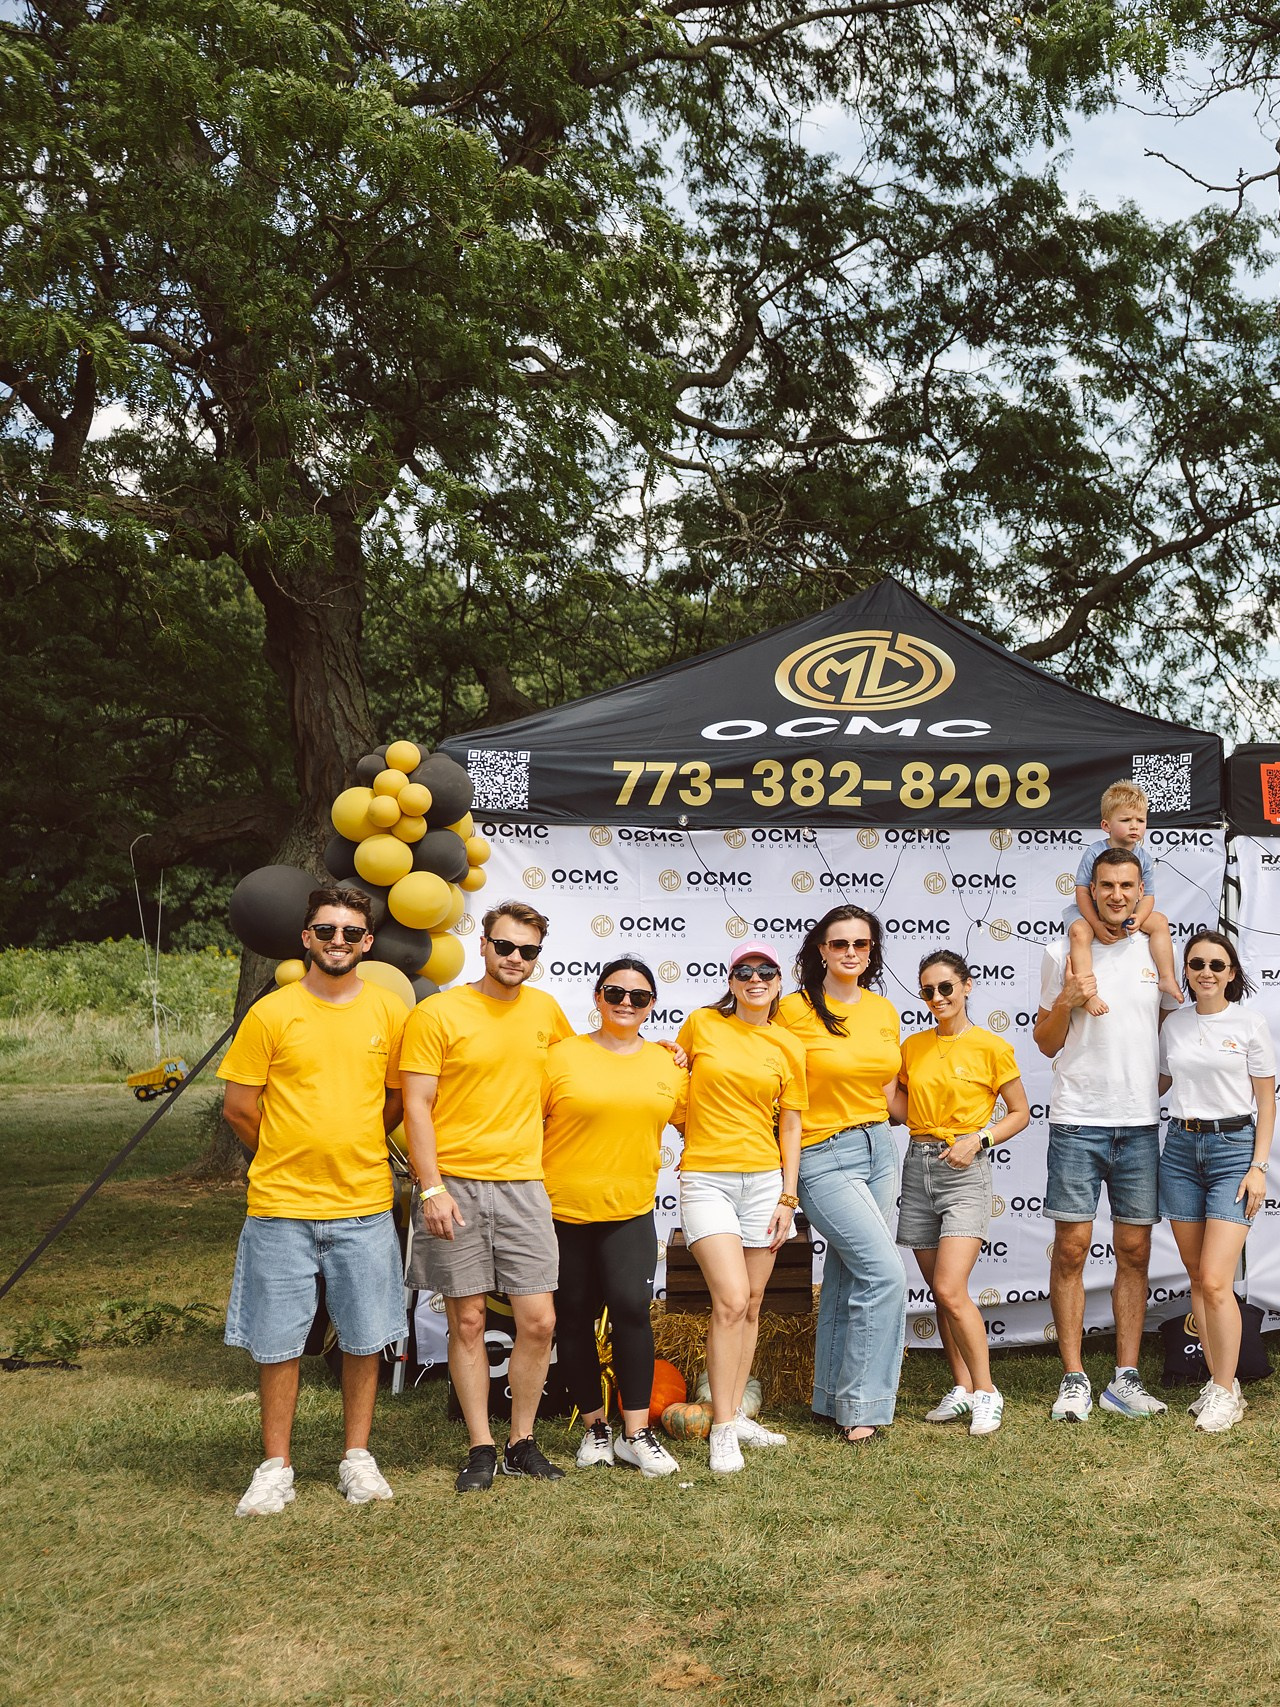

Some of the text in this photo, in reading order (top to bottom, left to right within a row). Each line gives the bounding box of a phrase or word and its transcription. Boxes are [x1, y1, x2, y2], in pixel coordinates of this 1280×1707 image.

[701, 716, 991, 741] OCMC
[612, 757, 1052, 810] 773-382-8208
[481, 822, 549, 839] OCMC
[617, 828, 684, 843] OCMC
[884, 828, 951, 844] OCMC
[1017, 830, 1083, 844] OCMC
[1149, 830, 1214, 846] OCMC
[551, 869, 618, 884] OCMC
[686, 871, 752, 885] OCMC
[819, 872, 884, 887] OCMC
[951, 874, 1017, 888] OCMC
[619, 917, 686, 931] OCMC
[885, 919, 950, 934] OCMC
[1017, 921, 1065, 935] OCM
[550, 961, 601, 976] OCM
[971, 964, 1015, 979] CMC
[644, 1009, 684, 1024] MC
[900, 1010, 939, 1025] CM
[1010, 1197, 1046, 1212] OC
